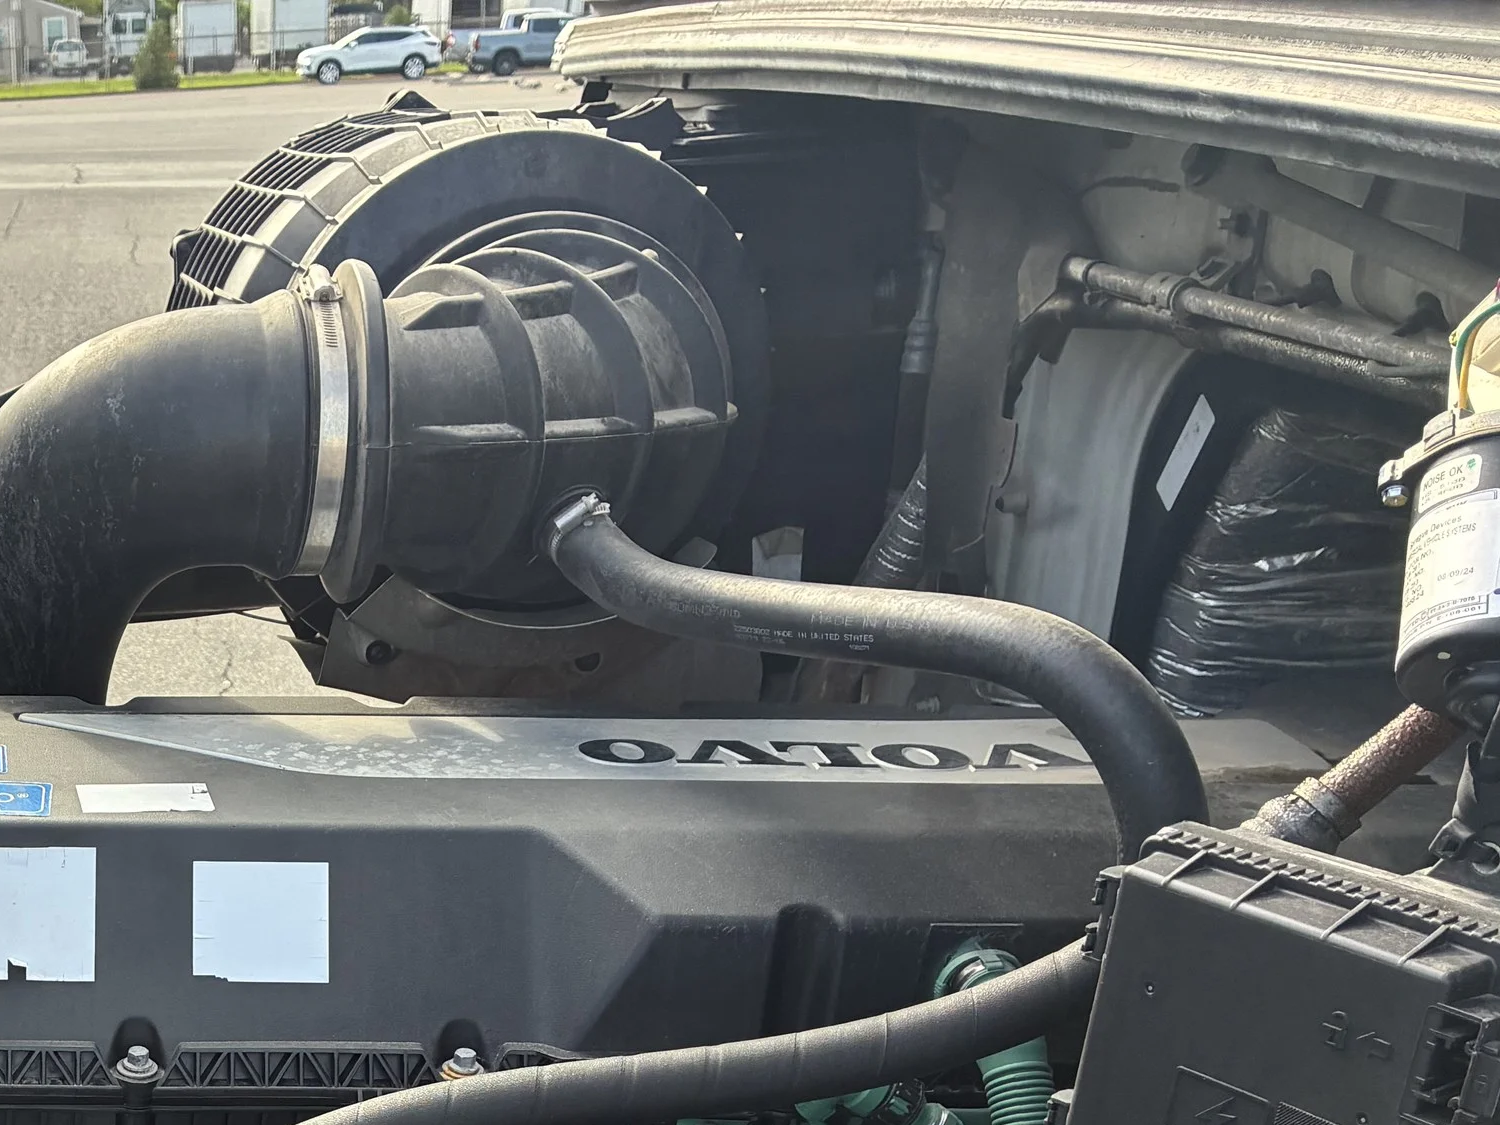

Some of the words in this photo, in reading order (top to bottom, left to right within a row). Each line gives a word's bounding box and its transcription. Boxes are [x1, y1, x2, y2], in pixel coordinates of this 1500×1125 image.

[1423, 471, 1445, 491] NOISE
[1449, 464, 1463, 477] OK
[1431, 516, 1461, 532] Devices
[843, 633, 874, 643] STATES
[578, 737, 1094, 772] VOLVO
